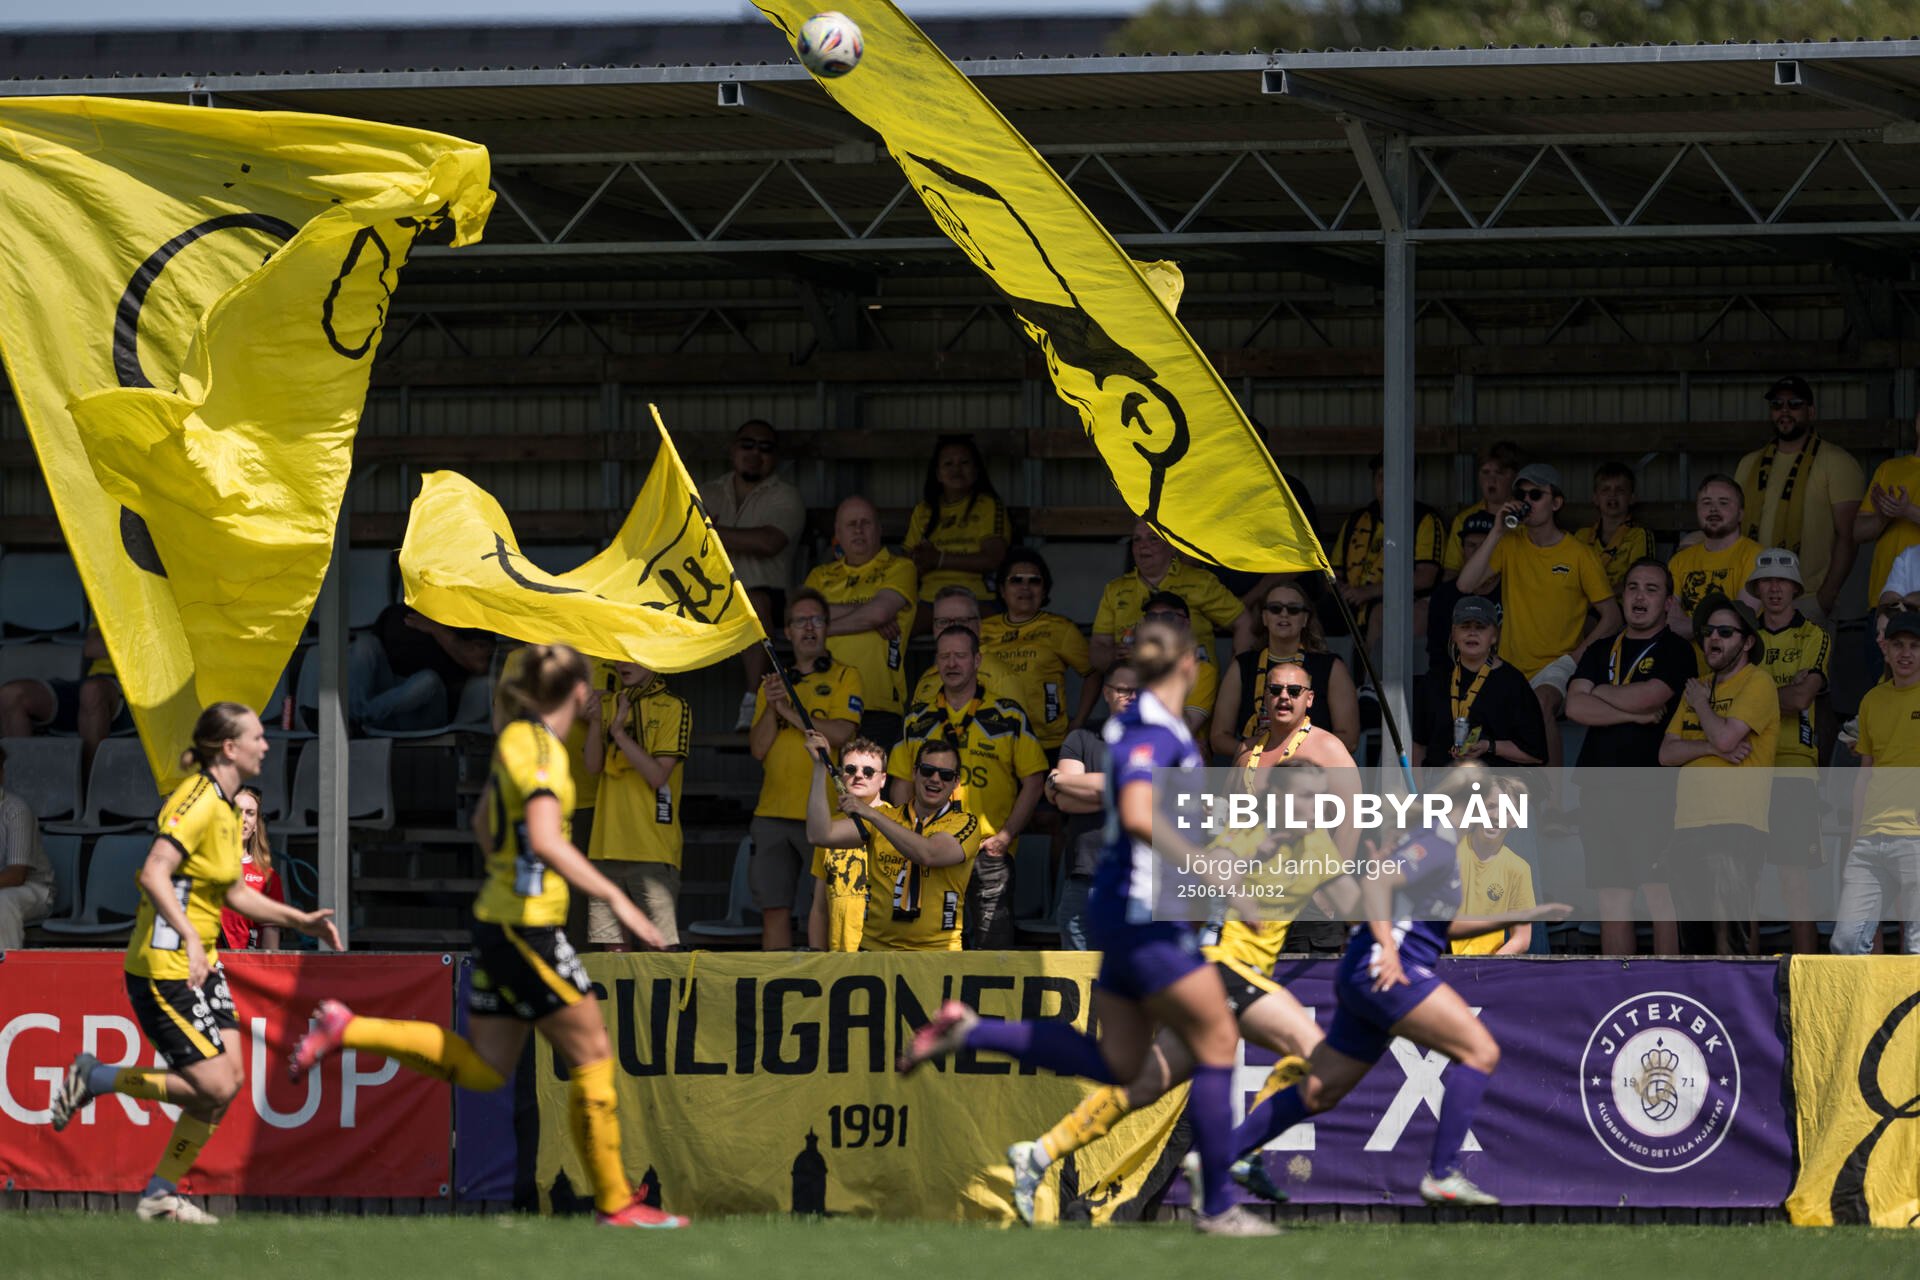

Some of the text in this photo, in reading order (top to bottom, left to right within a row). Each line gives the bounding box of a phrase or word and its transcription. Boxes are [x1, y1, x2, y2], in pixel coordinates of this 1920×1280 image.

[1600, 1003, 1723, 1055] JITEX BK
[0, 1012, 400, 1129] GRUP
[828, 1104, 909, 1148] 1991
[1597, 1098, 1726, 1158] KLUBBEN MED DET LILA HJÄRTAT
